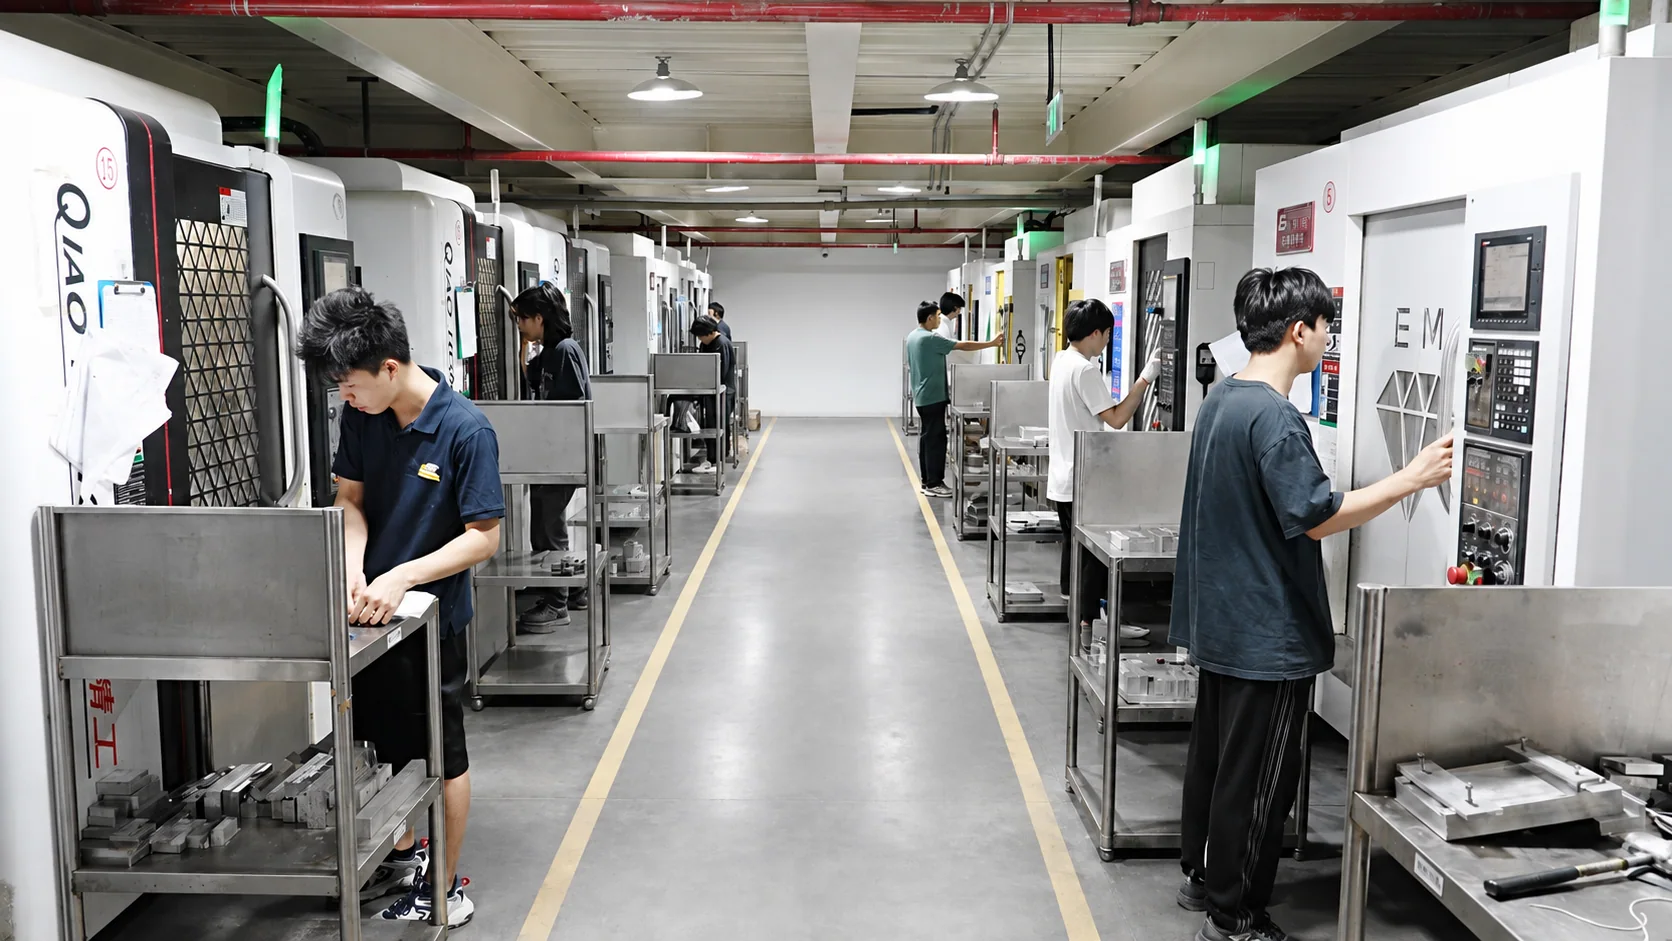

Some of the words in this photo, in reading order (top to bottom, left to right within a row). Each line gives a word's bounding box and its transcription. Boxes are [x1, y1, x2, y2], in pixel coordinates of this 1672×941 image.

[100, 156, 115, 181] 15
[57, 183, 91, 334] QIAO
[444, 241, 454, 317] QIAO
